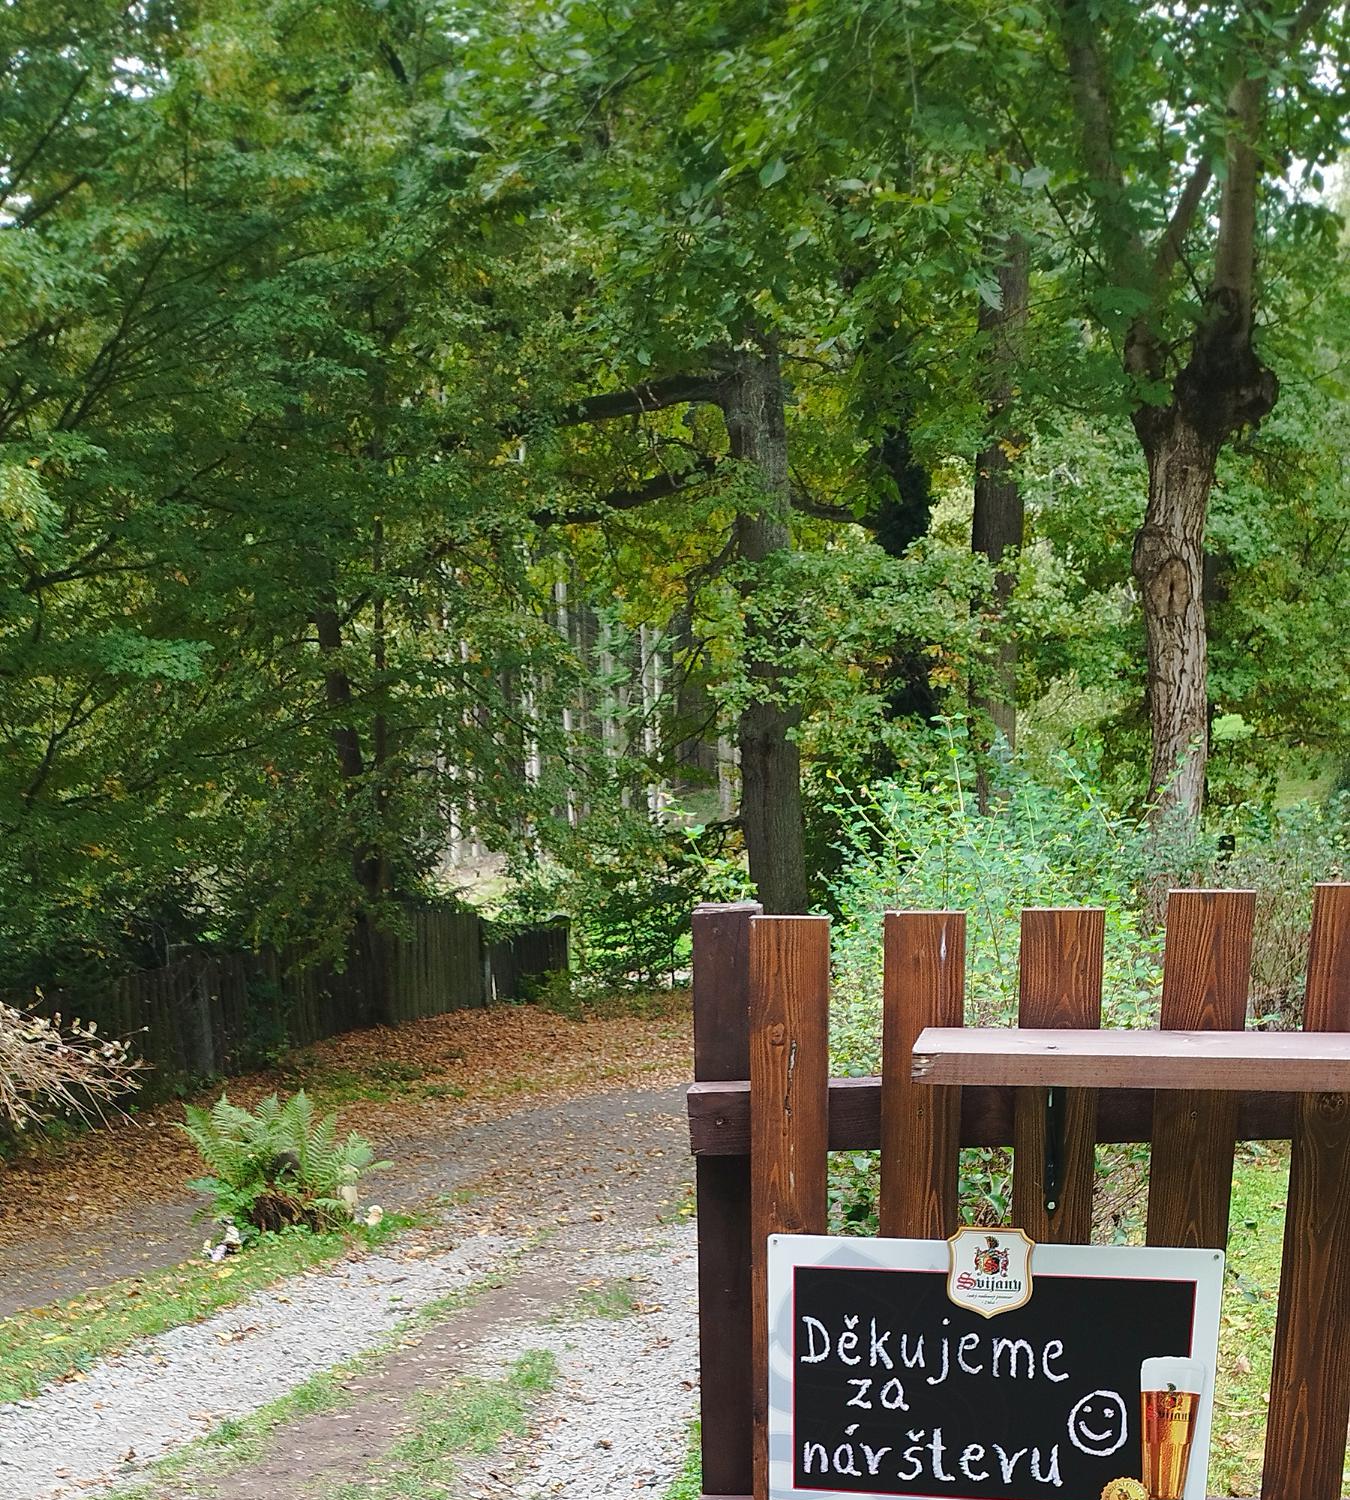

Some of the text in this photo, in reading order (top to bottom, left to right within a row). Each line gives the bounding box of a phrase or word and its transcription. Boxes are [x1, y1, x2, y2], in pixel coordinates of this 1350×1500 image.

[956, 1271, 1022, 1292] Svijany
[800, 1314, 1069, 1384] Děkujeme
[846, 1377, 910, 1411] za
